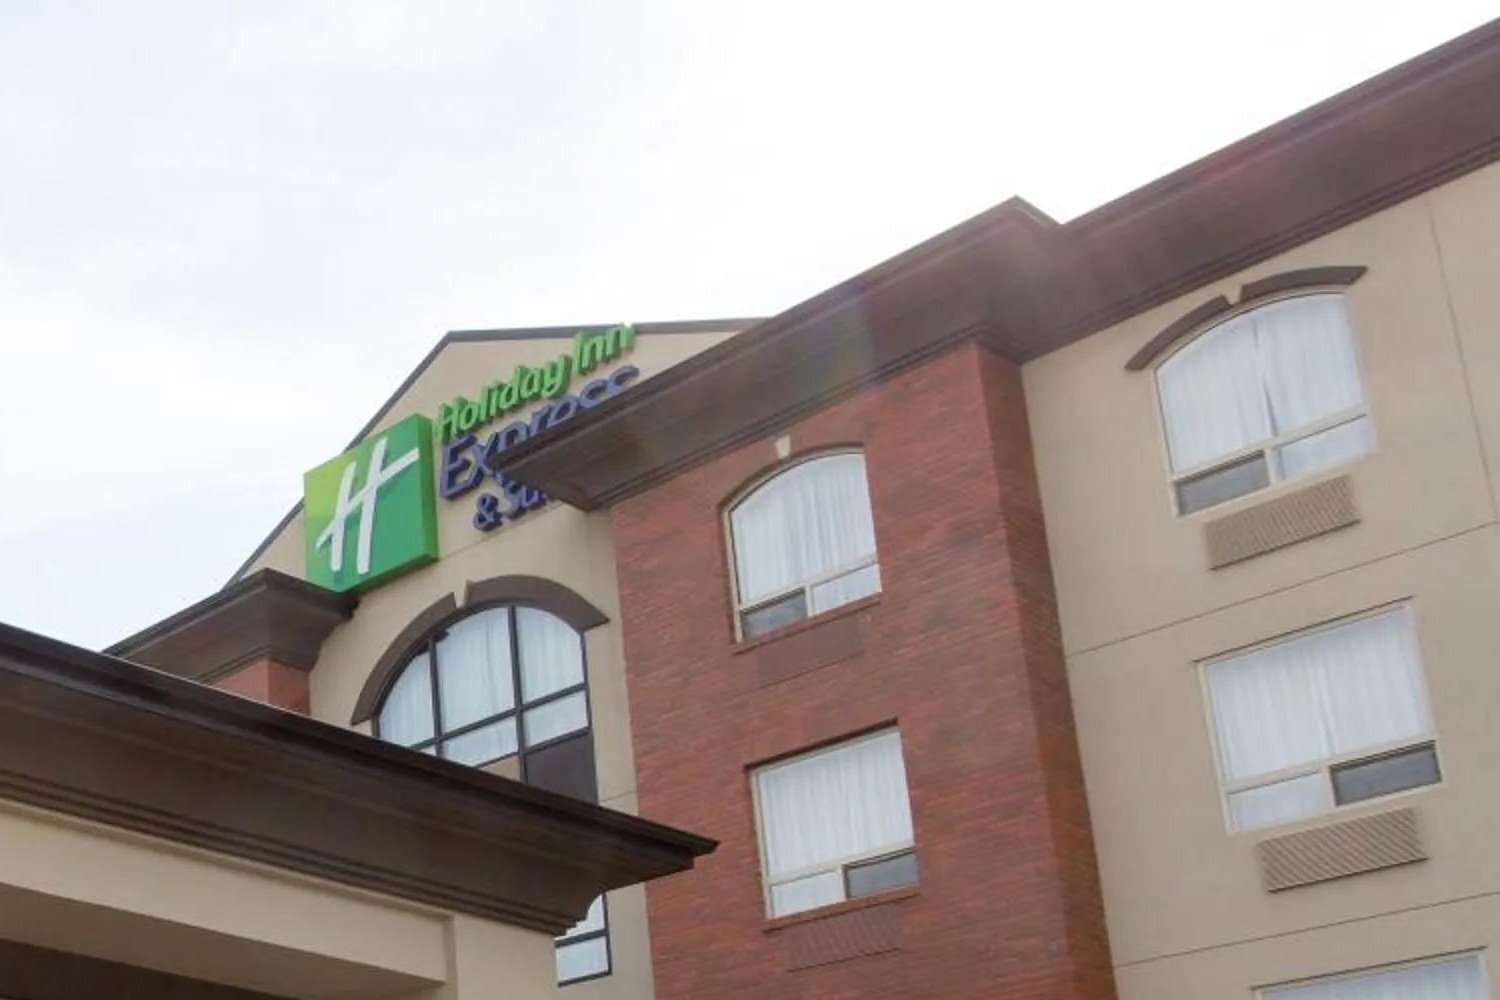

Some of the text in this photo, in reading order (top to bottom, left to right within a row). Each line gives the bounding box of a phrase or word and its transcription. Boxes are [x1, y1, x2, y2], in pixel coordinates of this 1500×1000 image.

[432, 323, 637, 445] Holiday Inn
[473, 493, 502, 532] &
